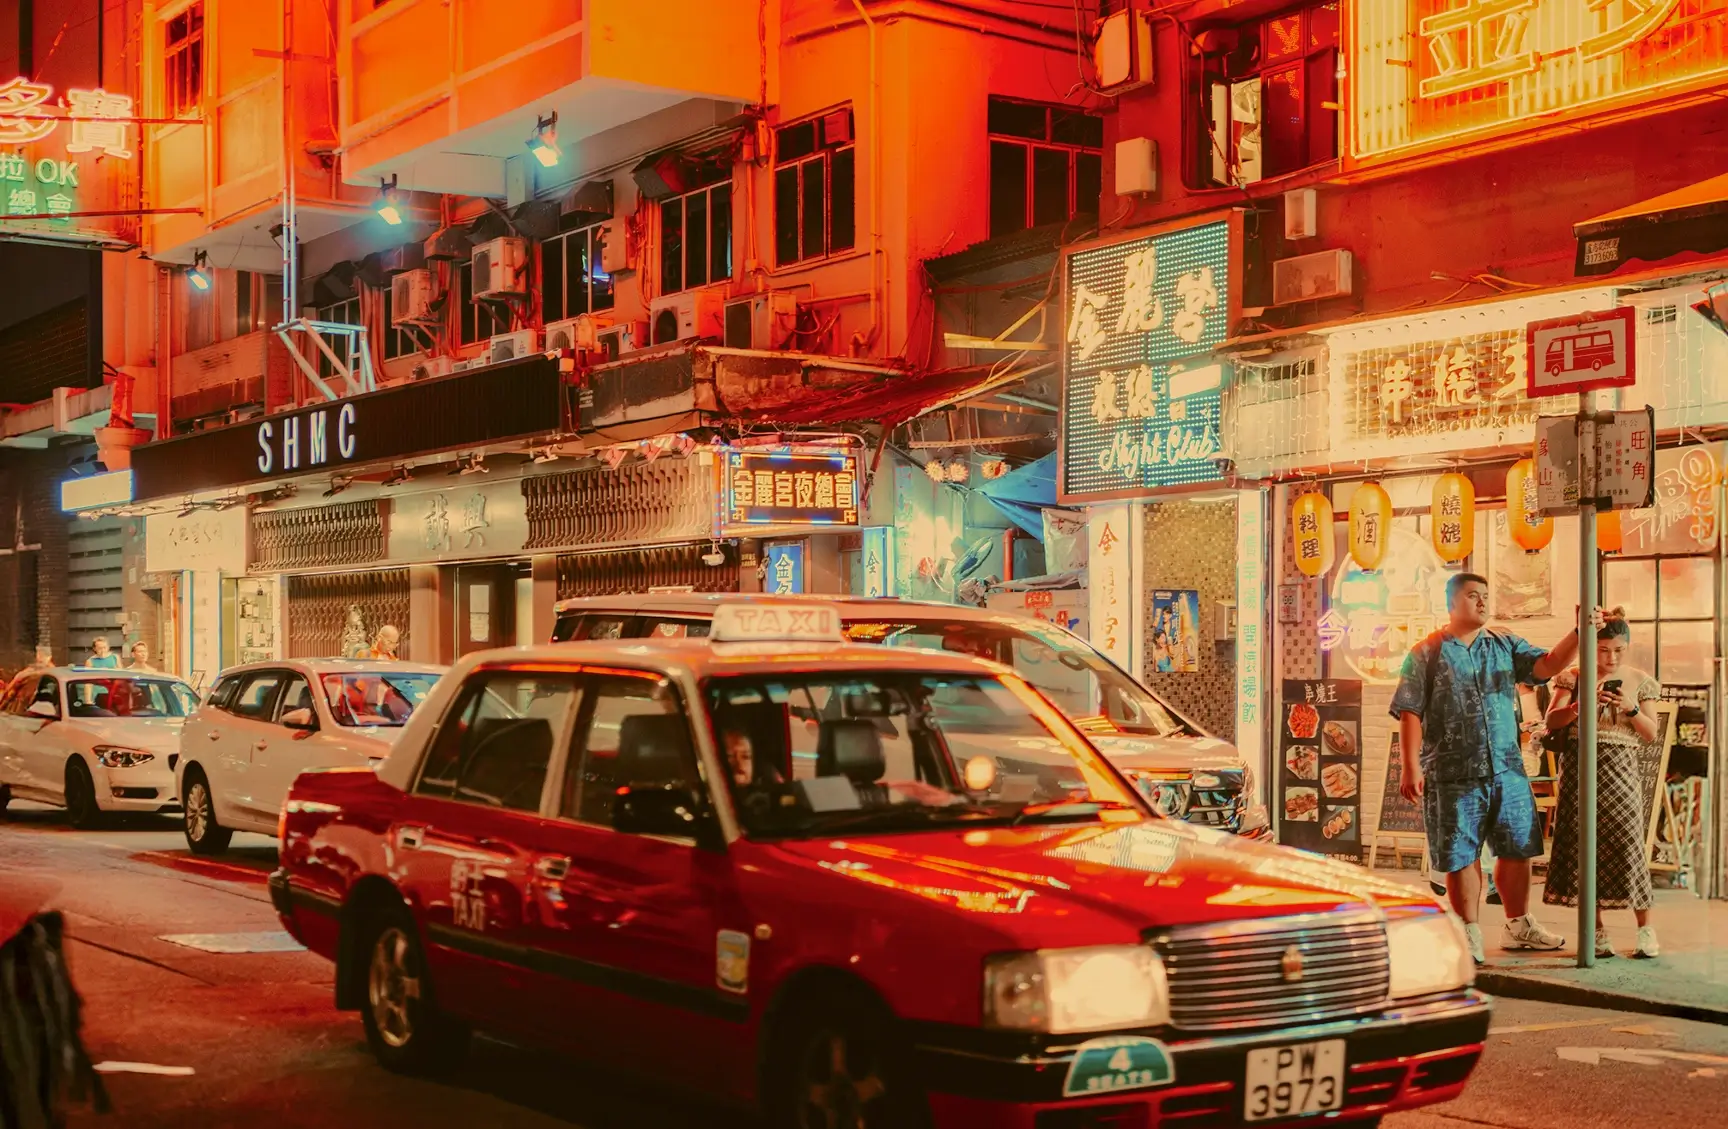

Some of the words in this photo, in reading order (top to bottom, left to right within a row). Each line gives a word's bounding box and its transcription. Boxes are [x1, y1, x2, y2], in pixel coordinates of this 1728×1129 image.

[1091, 362, 1187, 423] 夜總
[258, 402, 355, 474] SHMC
[1099, 428, 1161, 479] Night
[1166, 425, 1214, 466] Club
[1631, 430, 1646, 481] 旺角
[733, 470, 854, 509] 金麗宮夜總會
[1299, 512, 1321, 560] 料理
[1440, 494, 1462, 545] 燒烤
[734, 608, 831, 634] TAXI
[1304, 682, 1338, 703] 串燒王
[1086, 1069, 1153, 1091] SEATS
[1108, 1047, 1132, 1072] 4
[1276, 1046, 1318, 1080] PW
[1252, 1075, 1337, 1118] 3973
